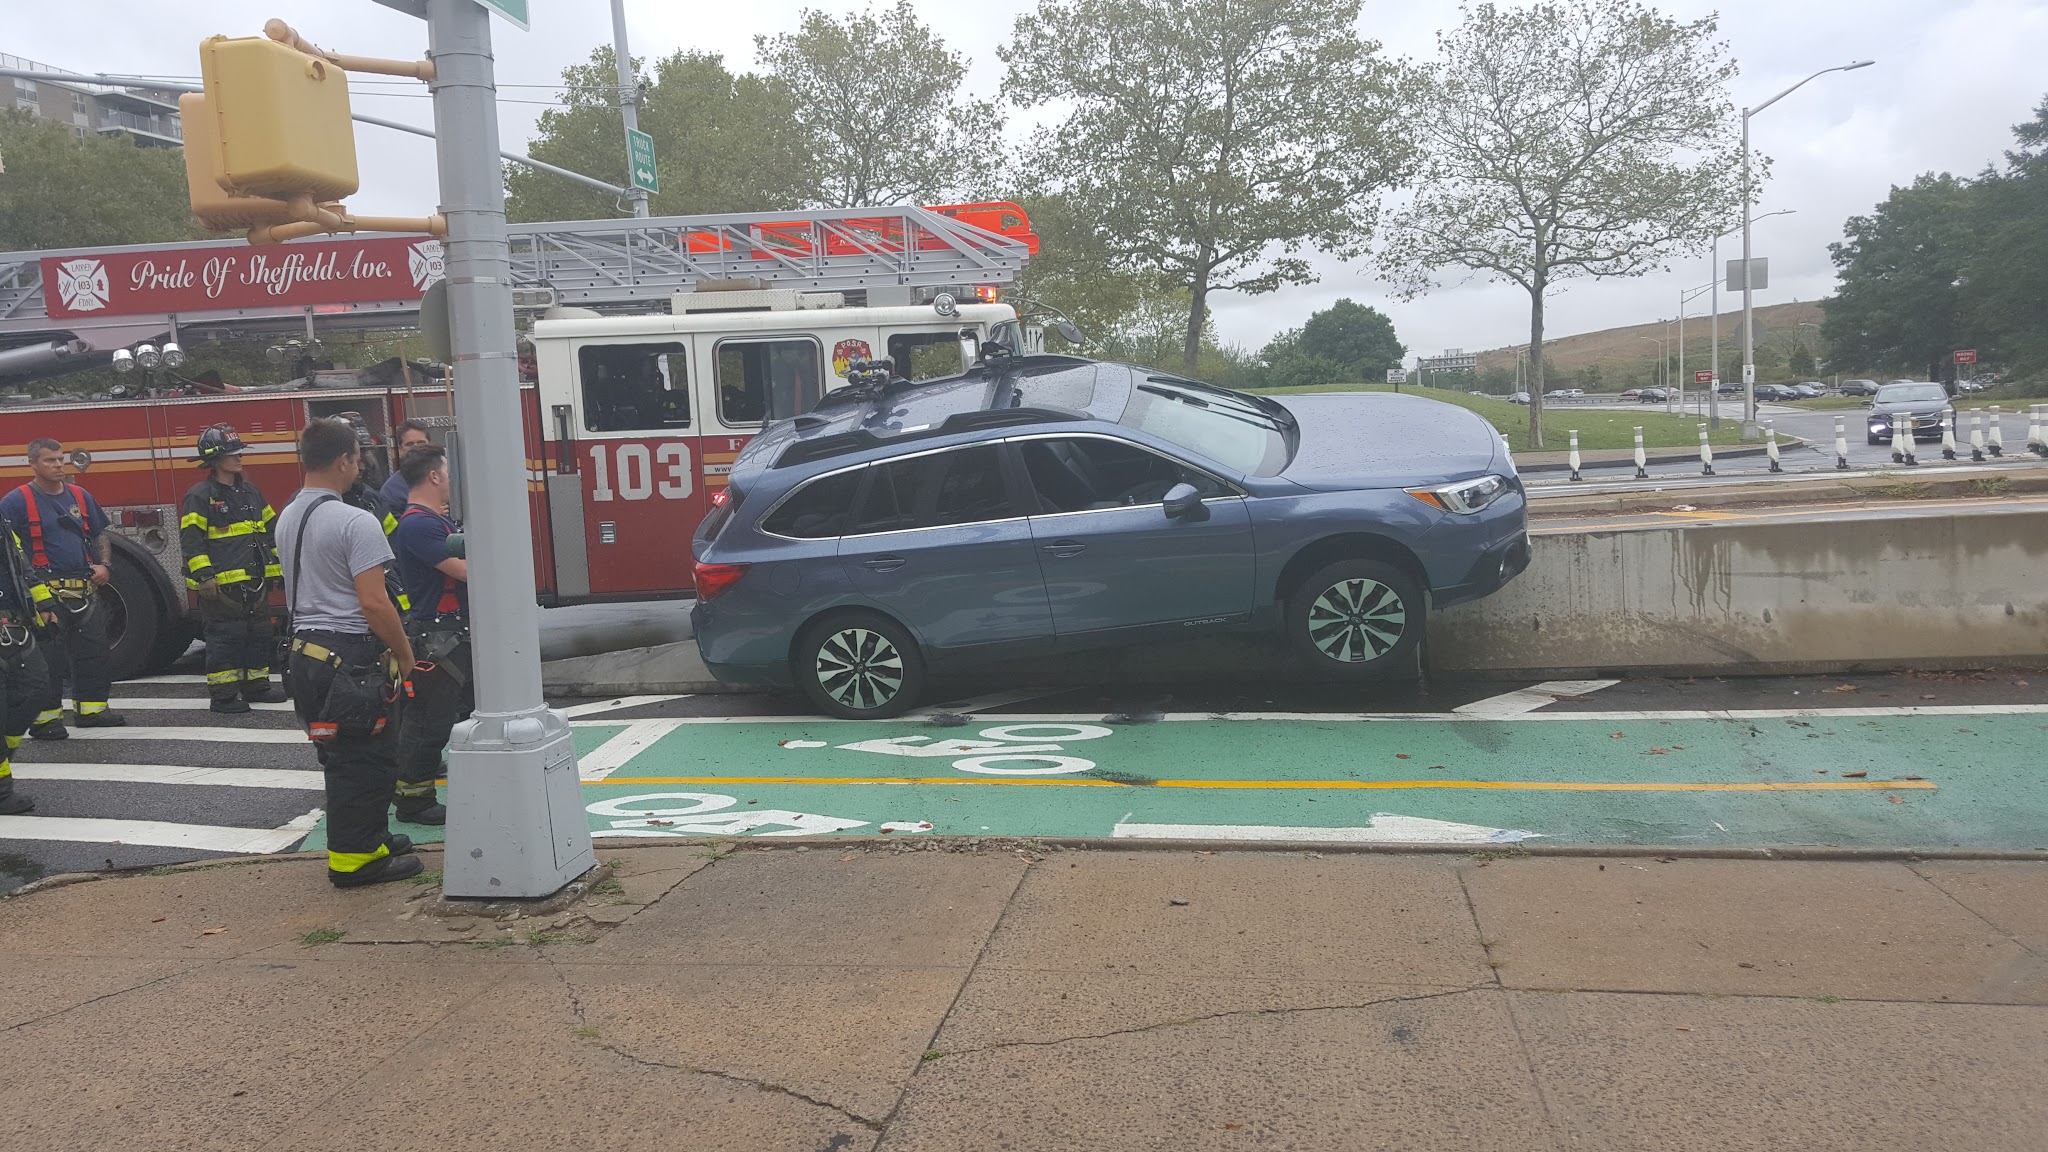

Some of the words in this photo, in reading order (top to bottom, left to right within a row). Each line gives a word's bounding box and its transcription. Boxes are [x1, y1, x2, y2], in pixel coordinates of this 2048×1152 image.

[633, 136, 650, 152] TRUCK
[635, 150, 652, 167] ROUTE
[71, 263, 92, 272] LADDER
[430, 261, 442, 271] 103
[130, 258, 197, 291] Pride
[202, 256, 236, 299] Of
[240, 251, 338, 296] Sheffield
[337, 249, 393, 279] Ave.
[78, 281, 91, 290] 103
[728, 438, 744, 451] F
[590, 443, 693, 502] 103
[1184, 617, 1227, 626] OUTBACK
